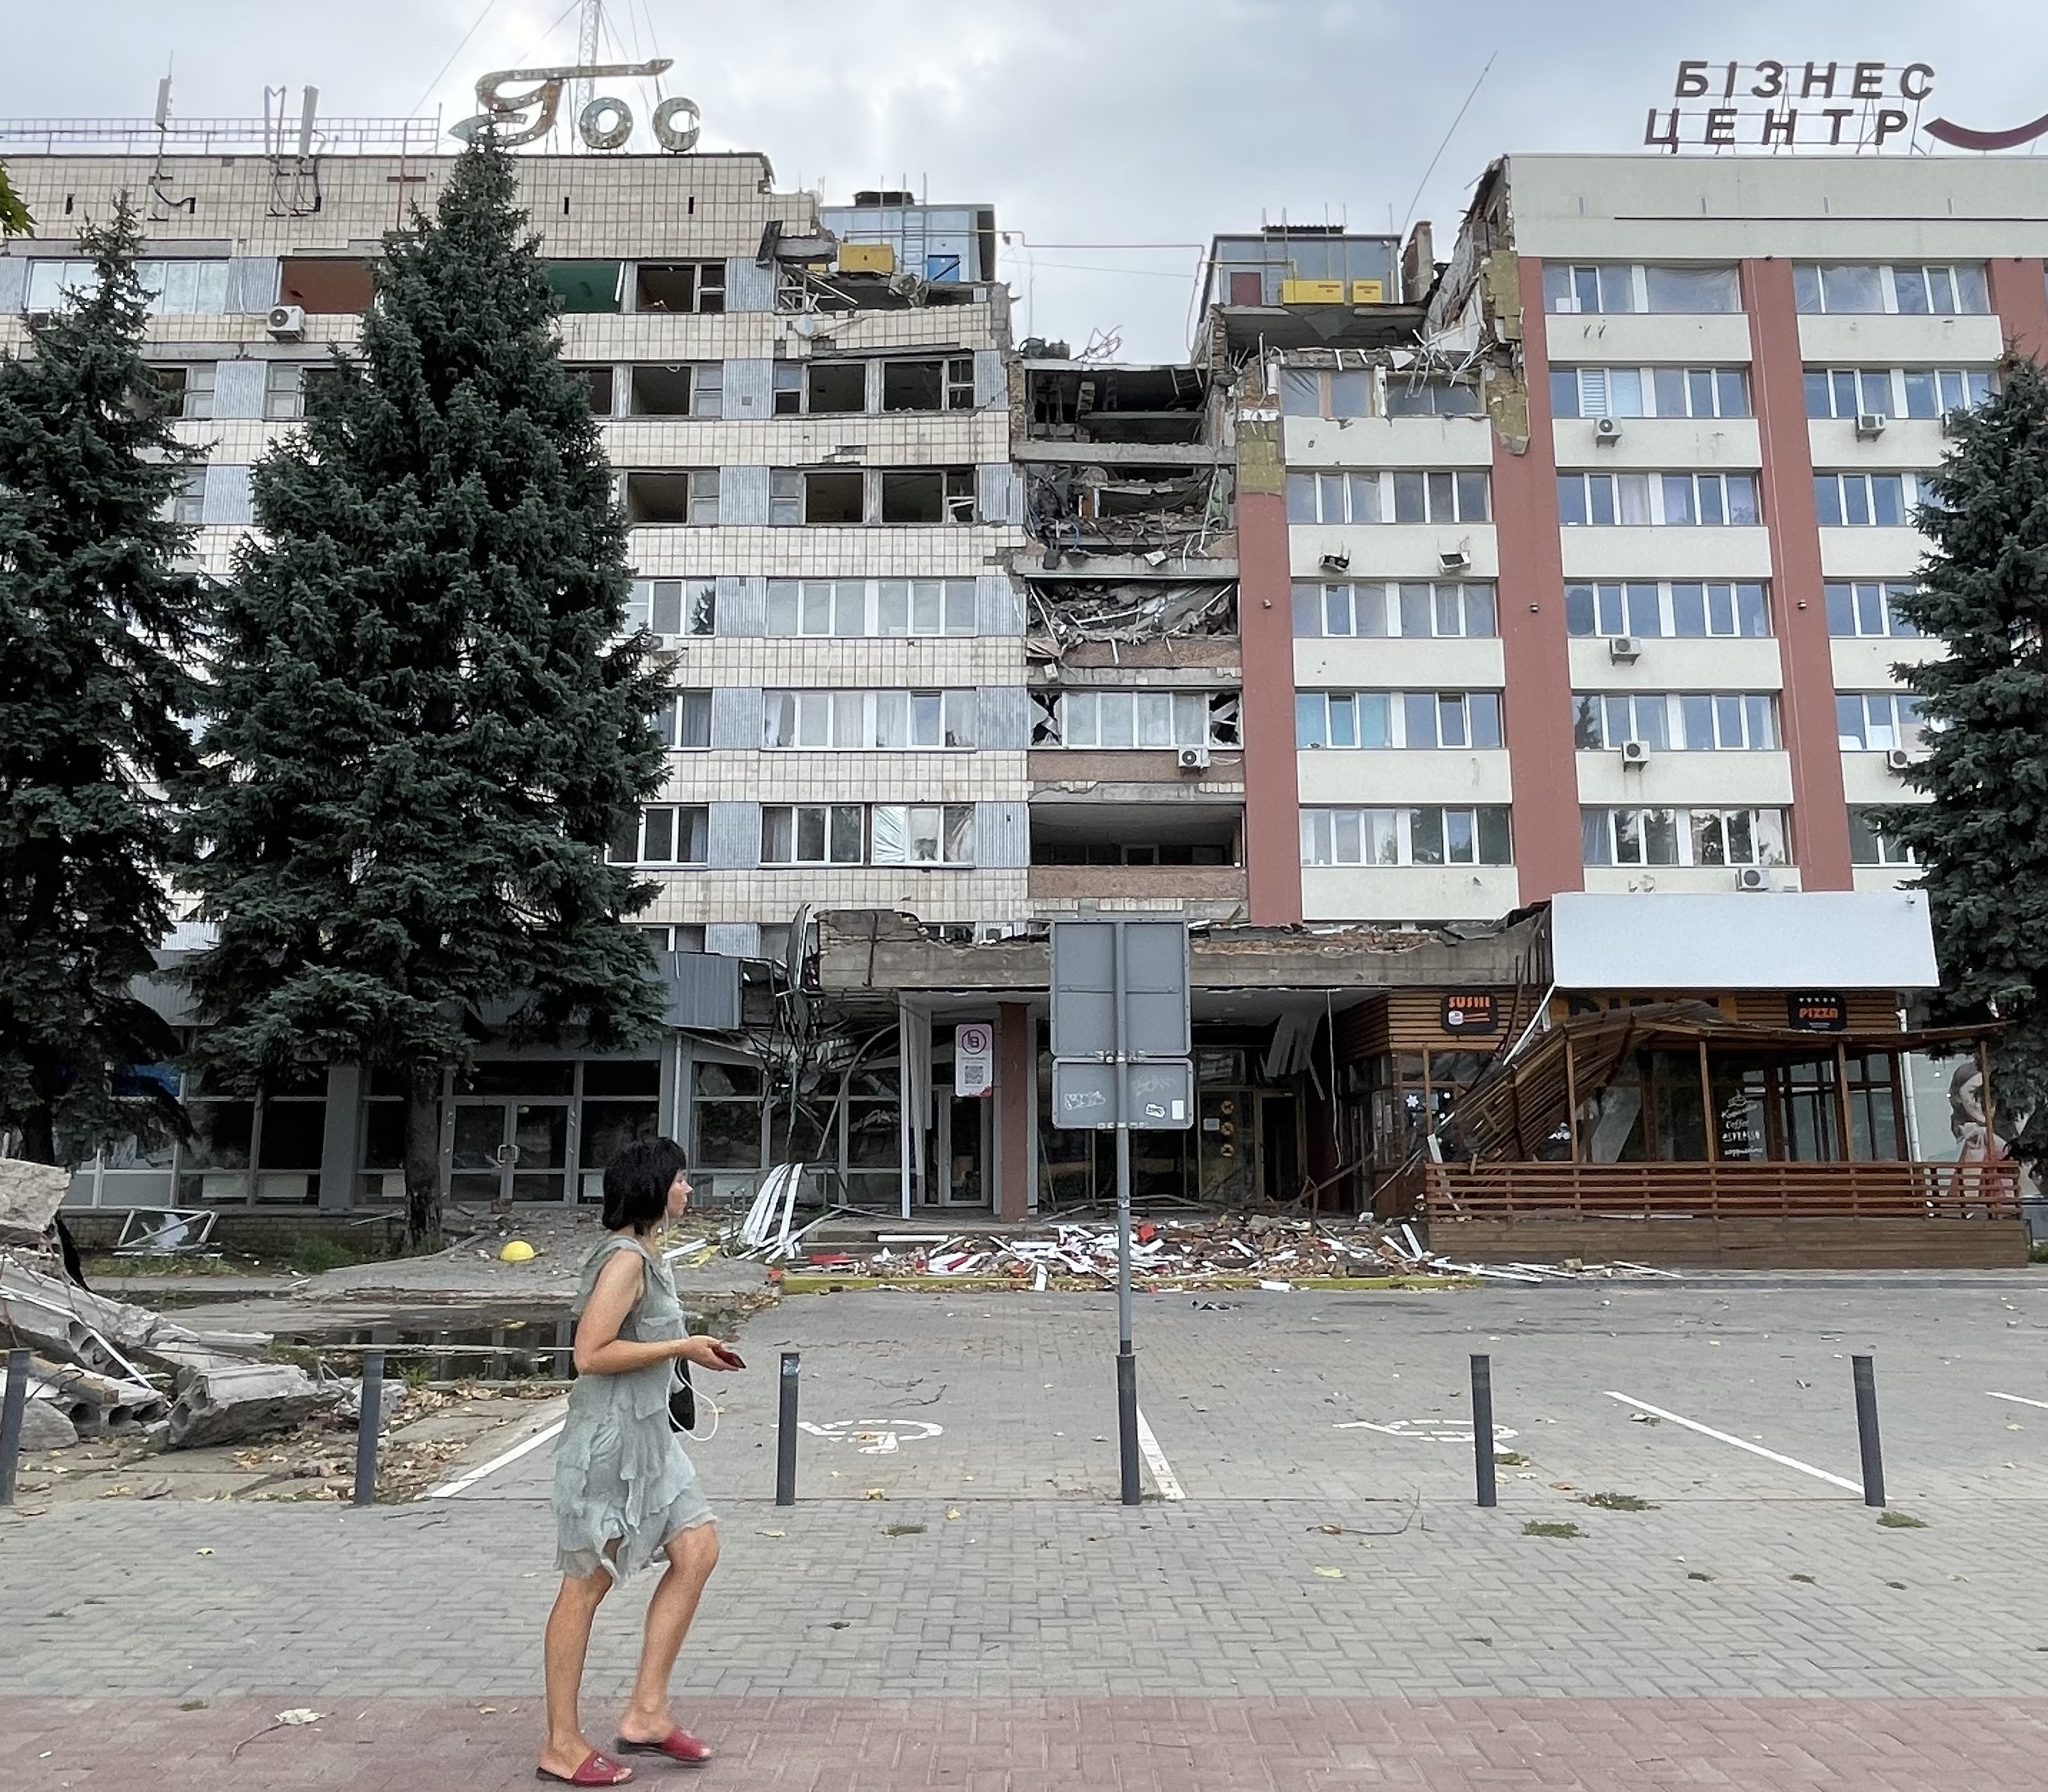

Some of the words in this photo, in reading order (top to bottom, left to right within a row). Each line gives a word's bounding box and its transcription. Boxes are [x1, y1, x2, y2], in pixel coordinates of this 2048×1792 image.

[1675, 60, 1936, 100] БІЗНЕС
[1644, 108, 1909, 154] ЦЕНТР
[1448, 996, 1491, 1008] SUSHI
